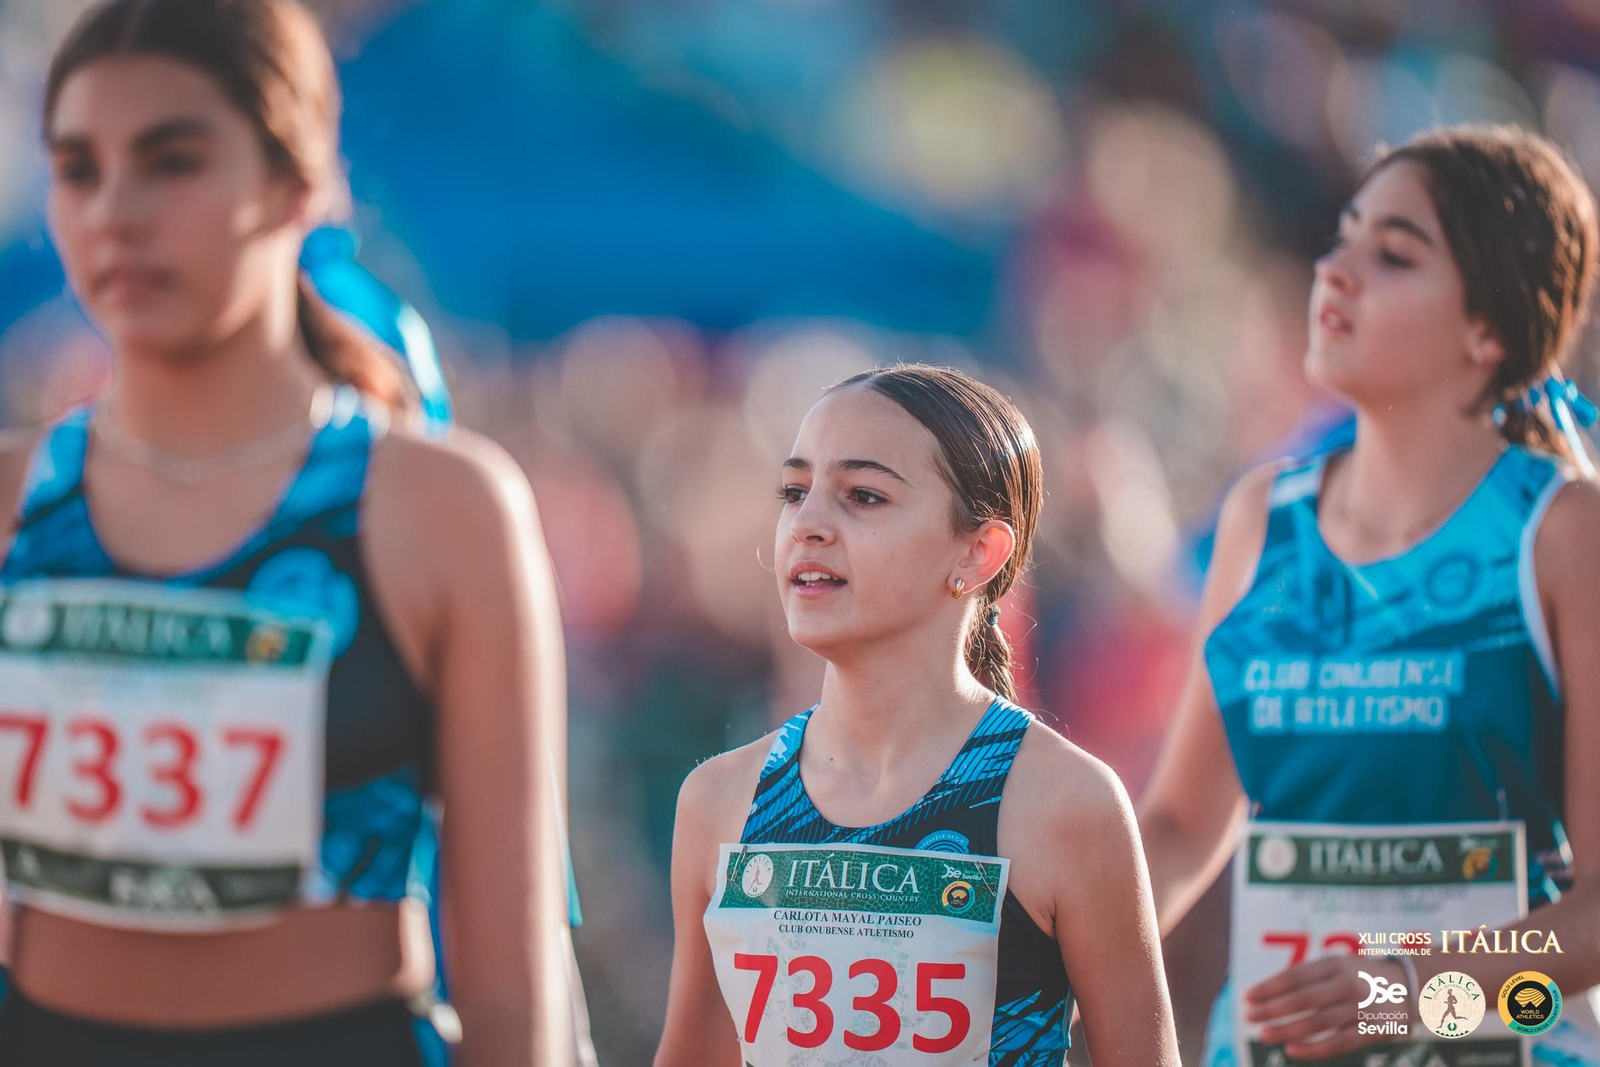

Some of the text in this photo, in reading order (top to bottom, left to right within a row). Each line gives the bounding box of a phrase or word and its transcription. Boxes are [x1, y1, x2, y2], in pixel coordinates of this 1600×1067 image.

[0, 710, 289, 833] 7337
[788, 853, 920, 894] ITÁLICA
[785, 889, 920, 903] INTERNATIONAL CROSS COUNTRY
[773, 909, 922, 927] CARLOTA MAYAL PAISEO
[778, 924, 914, 939] CLUB ONUBENSE ATLETISMO
[733, 952, 971, 1053] 7335
